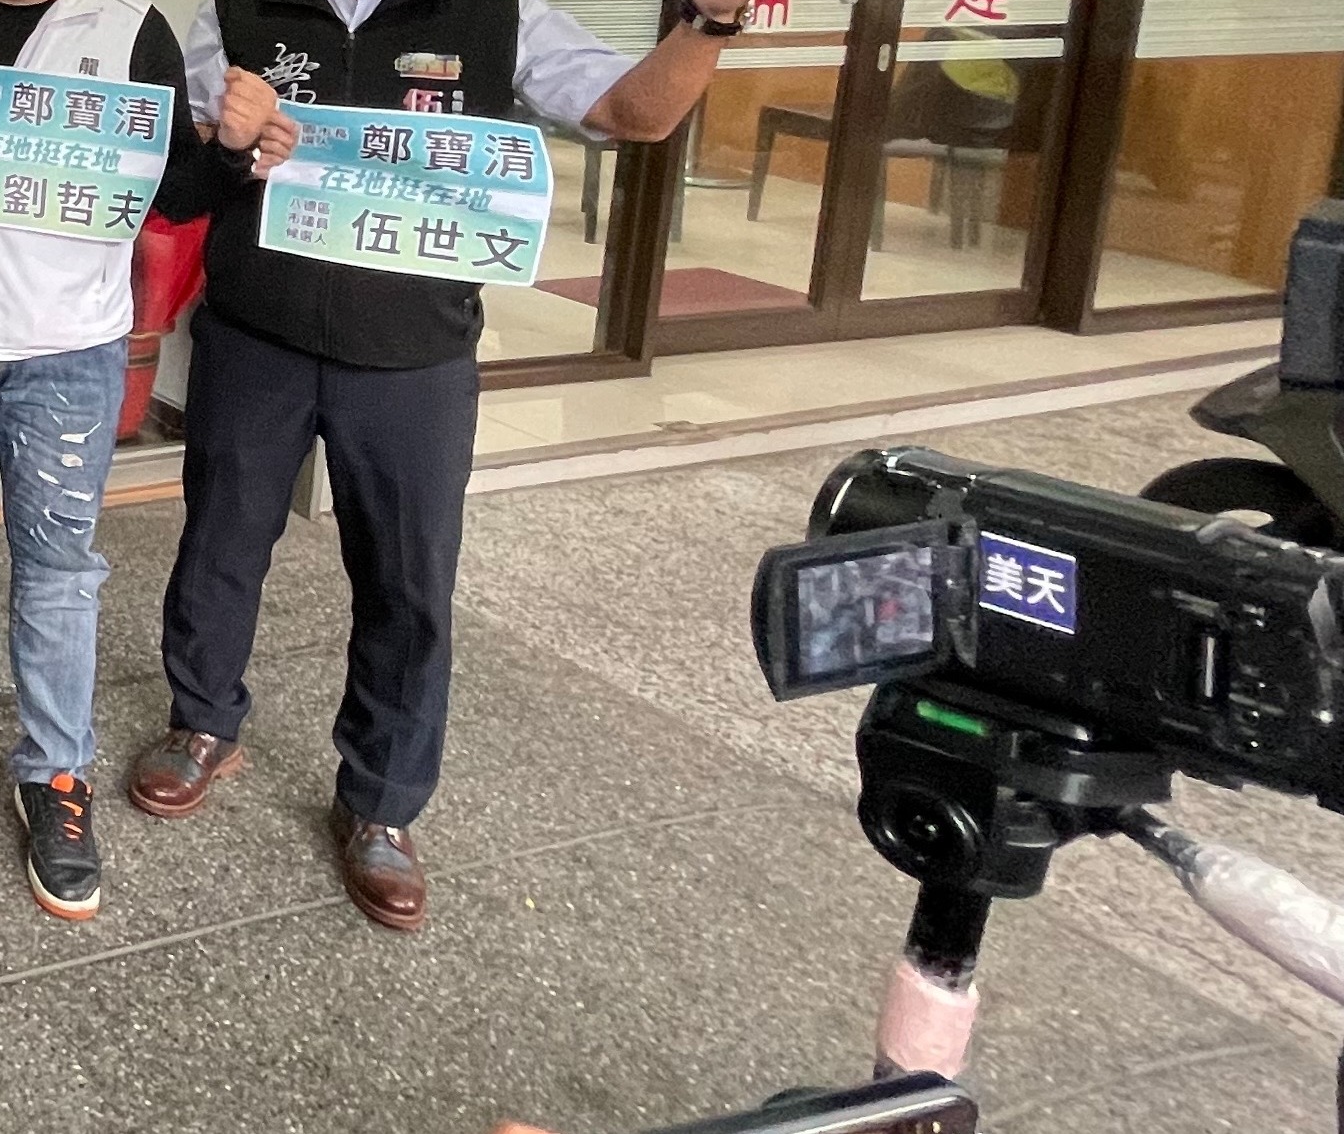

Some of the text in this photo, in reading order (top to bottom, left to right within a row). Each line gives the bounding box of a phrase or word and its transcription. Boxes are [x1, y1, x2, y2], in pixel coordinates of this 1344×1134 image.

[9, 82, 161, 140] 鄭寶清
[360, 124, 534, 181] 鄭寶清
[2, 174, 145, 230] 劉哲夫
[320, 166, 493, 213] 在地挺在地
[352, 209, 530, 273] 伍世文
[986, 554, 1065, 614] 美天
